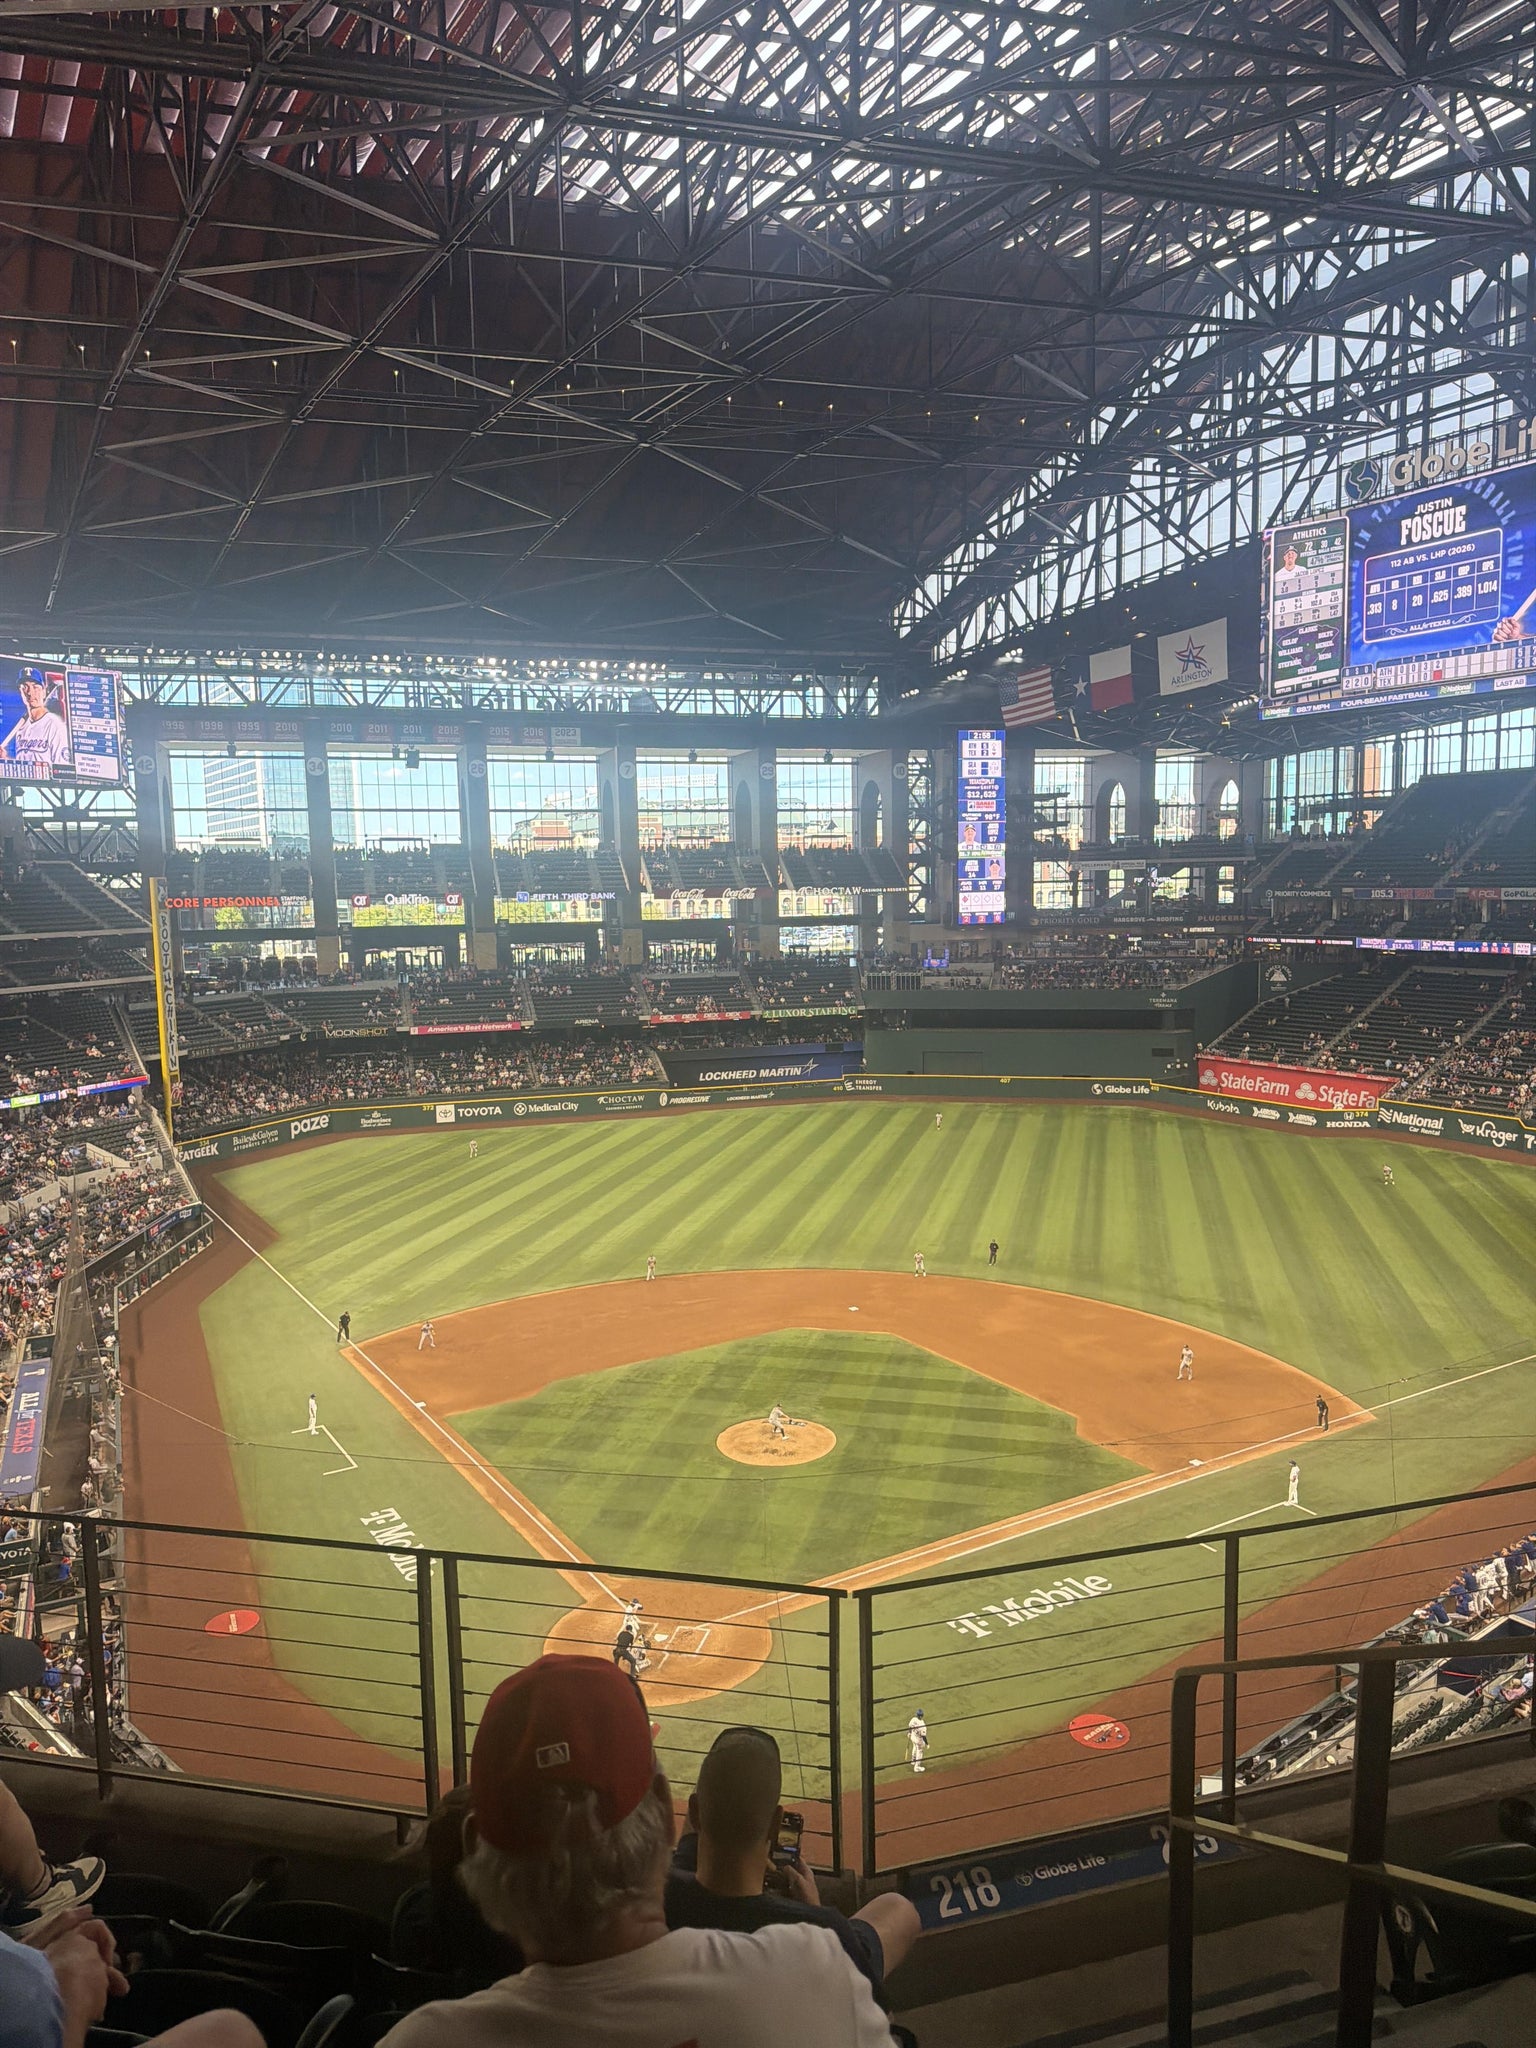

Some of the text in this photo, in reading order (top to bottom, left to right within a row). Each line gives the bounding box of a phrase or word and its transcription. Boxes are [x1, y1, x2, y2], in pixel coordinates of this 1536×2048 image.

[1389, 440, 1490, 487] Globe
[1415, 497, 1453, 515] JUSTIN
[1401, 505, 1467, 545] FOSCUE
[1292, 527, 1327, 540] ATHLETICS
[1304, 541, 1314, 552] 72
[1391, 543, 1476, 568] 112 AB VS. LHP (2026)
[1434, 570, 1446, 581] SLG
[1457, 565, 1470, 576] OBP
[1481, 560, 1495, 571] OPS
[1367, 580, 1498, 615] .313 8 20 .625 .389 1.014
[1379, 648, 1524, 677] ATH 0 0 3 2 5
[1171, 669, 1213, 686] ARLINGTON
[1379, 678, 1392, 687] TEX
[1423, 672, 1428, 681] 0
[1517, 659, 1523, 668] 2
[1345, 678, 1350, 688] 2
[1354, 676, 1360, 687] 2
[1363, 675, 1369, 686] 0
[1340, 696, 1387, 708] FOUR-SEAM
[1388, 690, 1430, 702] FASTBALL
[1313, 703, 1330, 712] MPH
[200, 721, 223, 730] 1998
[275, 722, 298, 731] 2010
[330, 723, 352, 733] 2010
[368, 723, 388, 733] 2011
[403, 724, 422, 734] 2011
[438, 725, 459, 735] 2012
[555, 728, 577, 737] 2023
[137, 759, 153, 771] 42
[308, 761, 324, 772] 34
[470, 763, 484, 774] 26
[624, 765, 631, 775] 7
[761, 765, 774, 777] 29
[561, 892, 589, 900] THIRD
[591, 892, 616, 900] BANK
[803, 886, 862, 896] CHOCTAW
[1371, 889, 1394, 898] 105.3
[165, 896, 280, 909] CORE PERSONNEL
[354, 893, 460, 907] QT QuikTrip QT
[1040, 917, 1075, 925] PRIORITY
[1197, 914, 1246, 922] PLUCKERS
[659, 1013, 677, 1021] DEX
[681, 1012, 698, 1020] DEX
[772, 1006, 857, 1018] LUXOR STAFFING
[325, 1027, 388, 1039] MOONSHOT
[427, 1022, 513, 1034] America's Best Network
[699, 1066, 803, 1082] LOCKHEED MARTIN
[1104, 1085, 1150, 1094] Globe Life
[602, 1095, 645, 1104] CHOCTAW
[669, 1095, 711, 1105] PROGRESSIVE
[457, 1106, 503, 1117] TOYOTA
[528, 1101, 580, 1113] Medical City
[1207, 1100, 1240, 1115] Kubota
[290, 1114, 330, 1139] paze
[360, 1117, 392, 1125] Budweiser
[1326, 1121, 1372, 1129] HONDA
[1392, 1110, 1444, 1131] National
[1420, 1128, 1440, 1136] Rental
[1476, 1120, 1519, 1148] Kroger
[178, 1142, 219, 1162] EATGEEK
[19, 1391, 40, 1411] ALL
[11, 1417, 36, 1455] TEXAS
[929, 1853, 1106, 1919] 218 Globe Life
